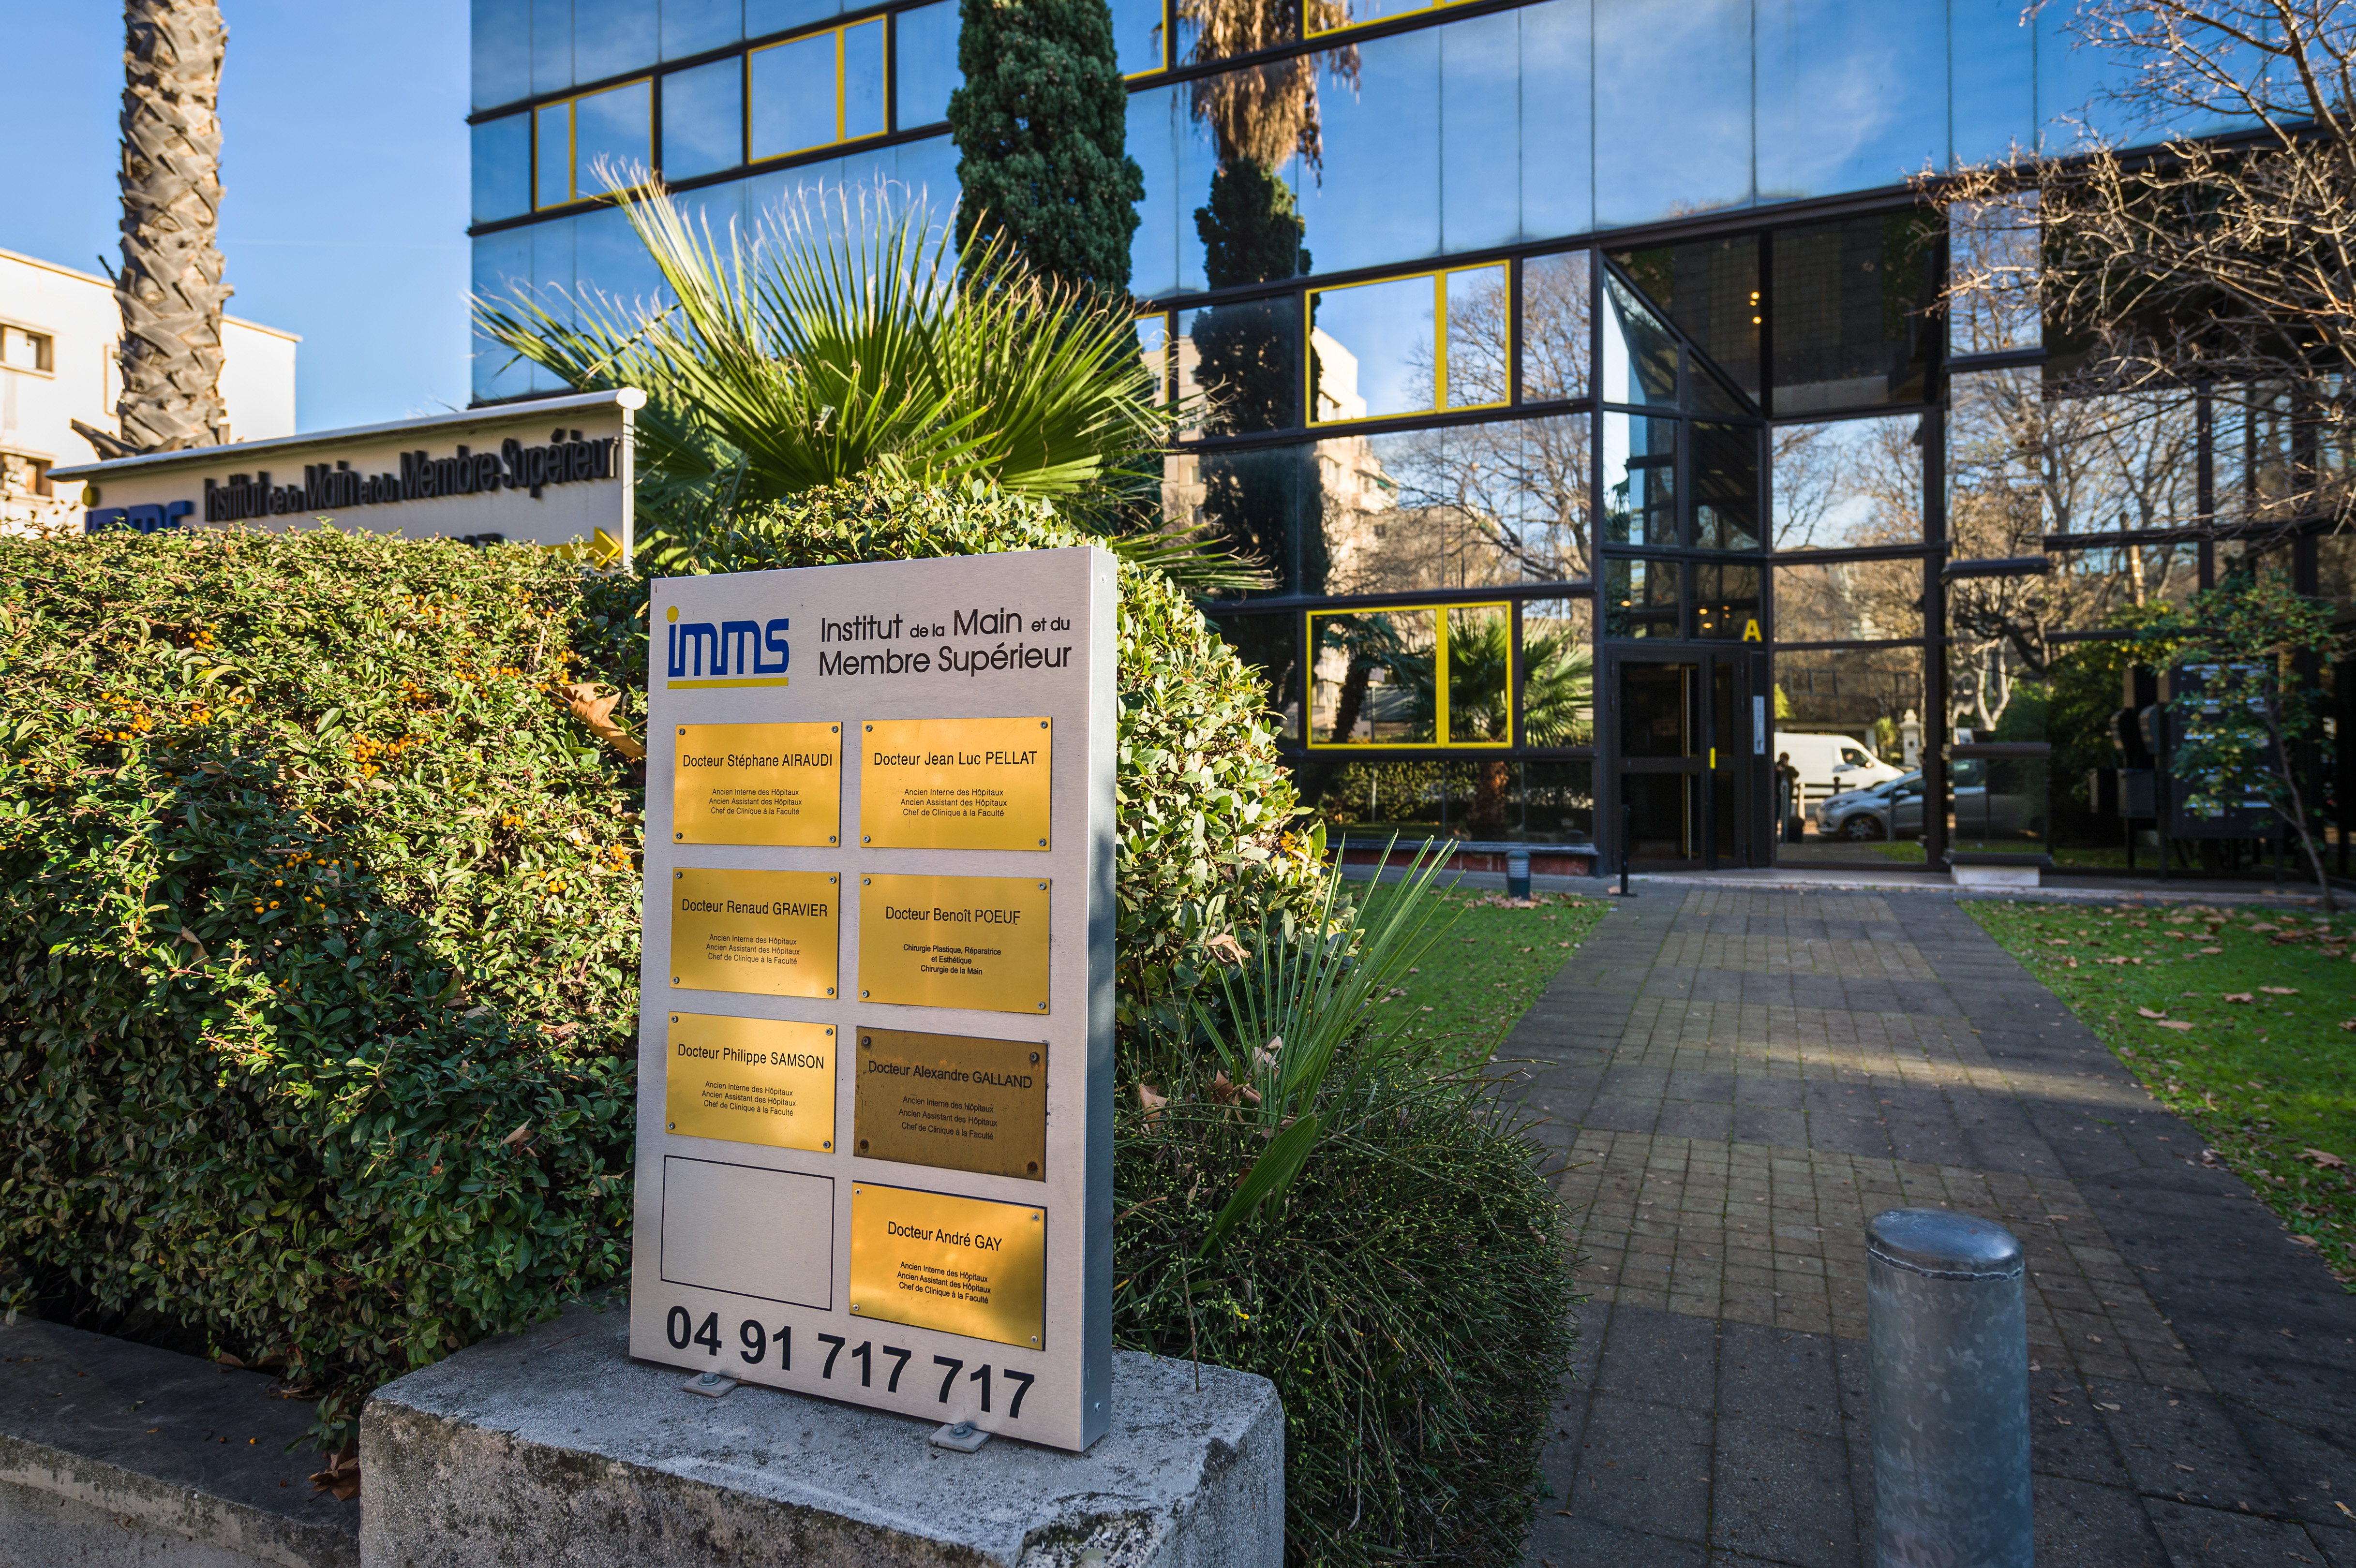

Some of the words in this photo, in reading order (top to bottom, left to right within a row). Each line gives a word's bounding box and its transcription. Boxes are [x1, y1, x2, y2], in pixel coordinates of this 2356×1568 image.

[205, 471, 269, 521] Institut
[269, 487, 287, 514] de
[287, 485, 305, 512] la
[305, 460, 361, 510] Main
[359, 475, 376, 503] et
[375, 473, 401, 503] du
[401, 445, 502, 498] Membre
[501, 428, 620, 498] Supérieur
[822, 614, 903, 642] Institut
[910, 624, 929, 638] de
[933, 623, 945, 637] la
[954, 607, 1022, 636] Main
[1031, 618, 1047, 632] et
[1051, 617, 1070, 631] du
[1743, 619, 1762, 642] A
[820, 649, 930, 676] Membre
[938, 642, 1072, 677] Supérieur
[683, 754, 724, 767] Docteur
[727, 754, 778, 769] Stéphane
[782, 754, 832, 766] AIRAUDI
[874, 753, 921, 765] Docteur
[924, 752, 954, 765] Jean
[959, 752, 981, 765] Luc
[986, 751, 1037, 765] PELLAT
[771, 788, 799, 797] Hôpitaux
[972, 788, 1003, 797] Hôpitaux
[774, 798, 802, 806] Hôpitaux
[975, 799, 1007, 807] Hôpitaux
[736, 807, 761, 815] Clinique
[932, 808, 960, 817] Clinique
[682, 898, 723, 912] Docteur
[727, 900, 768, 914] Renaud
[773, 902, 827, 917] GRAVIER
[886, 906, 930, 920] Docteur
[934, 908, 971, 922] Benoît
[975, 909, 1021, 924] POEUF
[769, 937, 796, 946] Hôpitaux
[903, 944, 931, 953] Chirurgie
[932, 945, 962, 954] Plastique,
[965, 947, 1001, 956] Réparatrice
[733, 954, 759, 963] Clinique
[772, 947, 800, 955] Hôpitaux
[939, 955, 971, 965] Esthétique
[921, 964, 948, 974] Chirurgie
[678, 1043, 719, 1059] Docteur
[723, 1047, 766, 1066] Philippe
[771, 1051, 823, 1069] SAMSON
[868, 1060, 910, 1076] Docteur
[913, 1065, 969, 1082] Alexandre
[972, 1071, 1032, 1089] GALLAND
[705, 1080, 726, 1089] Ancien
[728, 1083, 749, 1092] Interne
[765, 1087, 793, 1096] Hôpitaux
[701, 1090, 722, 1098] Ancien
[724, 1092, 752, 1102] Assistant
[768, 1097, 796, 1106] Hôpitaux
[902, 1096, 925, 1106] Ancien
[926, 1098, 949, 1108] Interne
[950, 1101, 962, 1109] des
[964, 1102, 993, 1113] Hôpitaux
[703, 1099, 718, 1108] Chef
[730, 1102, 755, 1112] Clinique
[770, 1107, 793, 1116] Faculté
[898, 1108, 921, 1117] Ancien
[922, 1111, 953, 1122] Assistant
[954, 1115, 966, 1123] des
[968, 1116, 997, 1126] Hôpitaux
[901, 1122, 917, 1130] Chef
[928, 1125, 954, 1136] Clinique
[969, 1130, 994, 1139] Faculté
[888, 1221, 933, 1241] Docteur
[935, 1228, 970, 1246] André
[975, 1234, 1002, 1251] GAY
[900, 1261, 921, 1271] Ancien
[924, 1265, 944, 1275] Interne
[946, 1269, 958, 1277] des
[960, 1271, 988, 1283] Hôpitaux
[897, 1271, 918, 1281] Ancien
[919, 1274, 948, 1286] Assistant
[949, 1280, 961, 1288] des
[963, 1282, 991, 1294] Hôpitaux
[899, 1281, 914, 1290] Chef
[925, 1286, 950, 1297] Clinique
[965, 1293, 988, 1304] Faculté
[667, 1306, 722, 1356] 04
[740, 1320, 791, 1371] 91
[818, 1333, 912, 1393] 717
[934, 1355, 1034, 1419] 717
